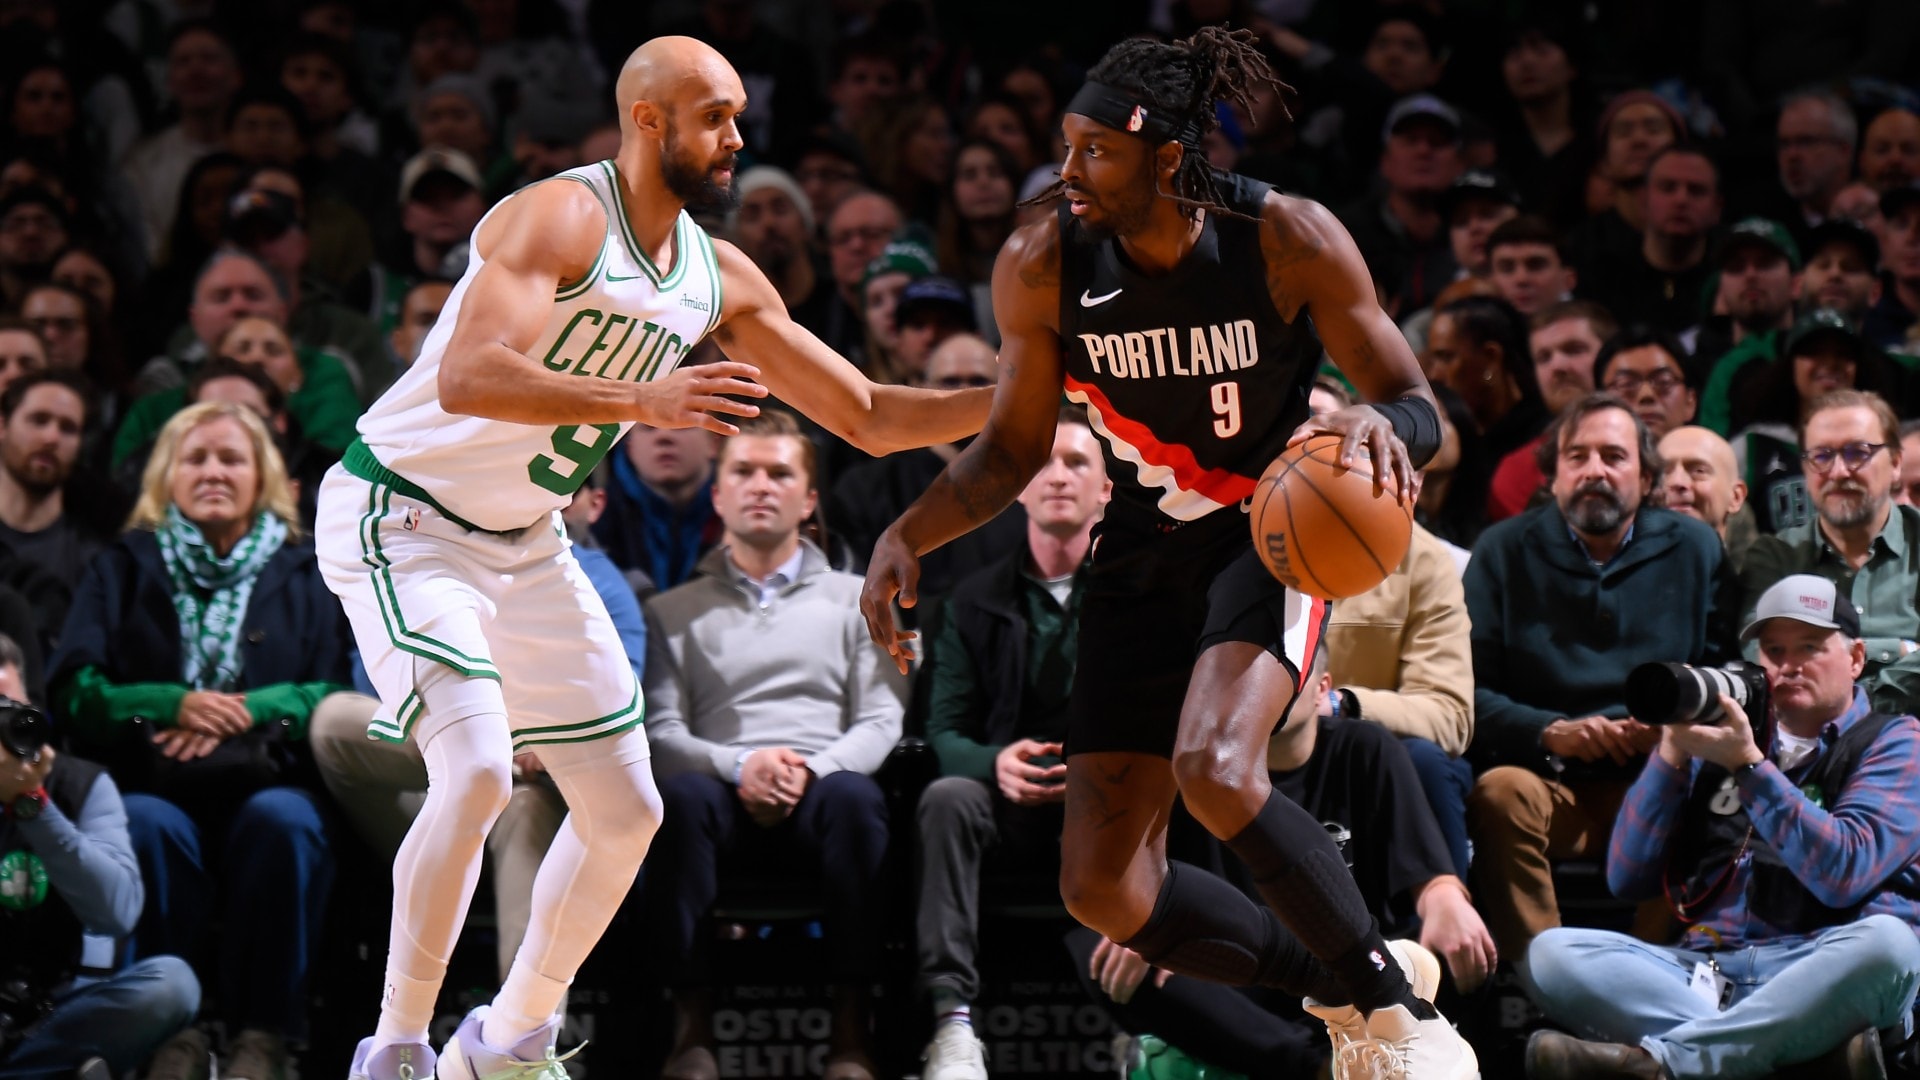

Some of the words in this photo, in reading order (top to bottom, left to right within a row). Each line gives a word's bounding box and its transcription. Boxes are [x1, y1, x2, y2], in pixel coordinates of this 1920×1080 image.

[680, 293, 708, 312] Amica
[1077, 319, 1259, 379] PORTLAND
[1210, 381, 1242, 438] 9
[527, 423, 620, 496] 9
[712, 1008, 833, 1041] OSTO
[972, 1004, 1111, 1037] OSTO
[717, 1044, 832, 1078] ELTIC
[994, 1041, 1114, 1073] ELTIC
